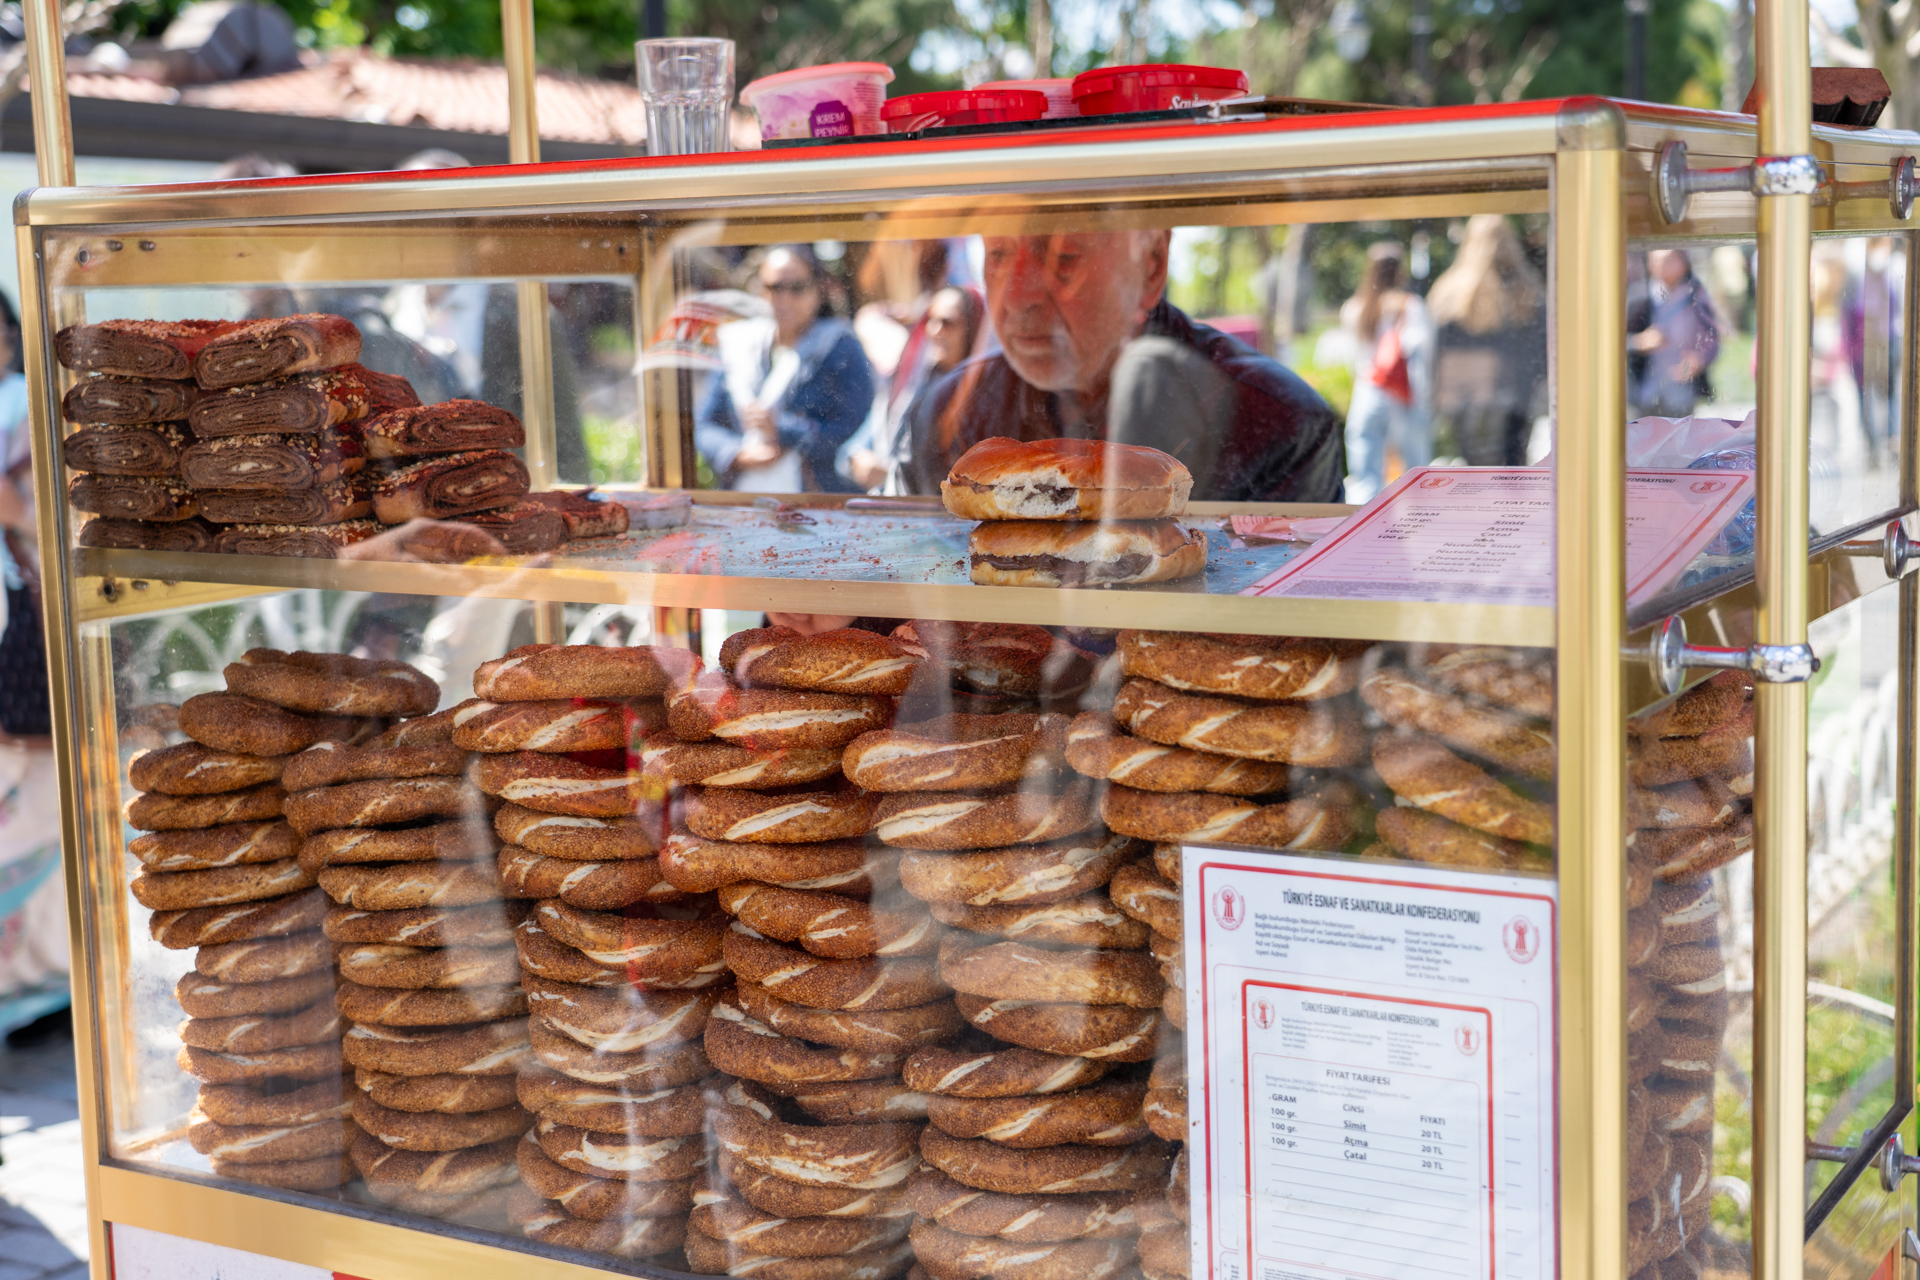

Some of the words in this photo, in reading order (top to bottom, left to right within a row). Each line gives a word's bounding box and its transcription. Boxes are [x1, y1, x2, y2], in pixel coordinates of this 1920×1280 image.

[815, 112, 846, 125] KREM
[1314, 894, 1339, 909] ESNAF
[1339, 897, 1349, 911] VE
[1350, 898, 1405, 917] SANATKARLAR
[1406, 904, 1481, 924] KONFEDERASYONU
[1324, 1003, 1341, 1016] ESNAF
[1341, 1006, 1348, 1017] VE
[1349, 1007, 1387, 1022] SANATKARLAR
[1388, 1012, 1440, 1028] KONFEDERASYONU
[1272, 1093, 1297, 1103] GRAM
[1270, 1107, 1285, 1116] 100
[1286, 1110, 1298, 1119] gr.
[1271, 1122, 1285, 1131] 100
[1287, 1125, 1298, 1133] gr.
[1343, 1120, 1367, 1131] Simit
[1421, 1129, 1432, 1138] 20
[1432, 1131, 1443, 1140] TL
[1271, 1136, 1286, 1146] 100
[1287, 1140, 1299, 1148] gr.
[1344, 1136, 1369, 1148] Açma
[1343, 1150, 1367, 1161] Çatal
[1421, 1145, 1432, 1153] 20
[1433, 1146, 1443, 1155] TL
[1421, 1160, 1432, 1169] 20
[1433, 1161, 1444, 1170] TL
